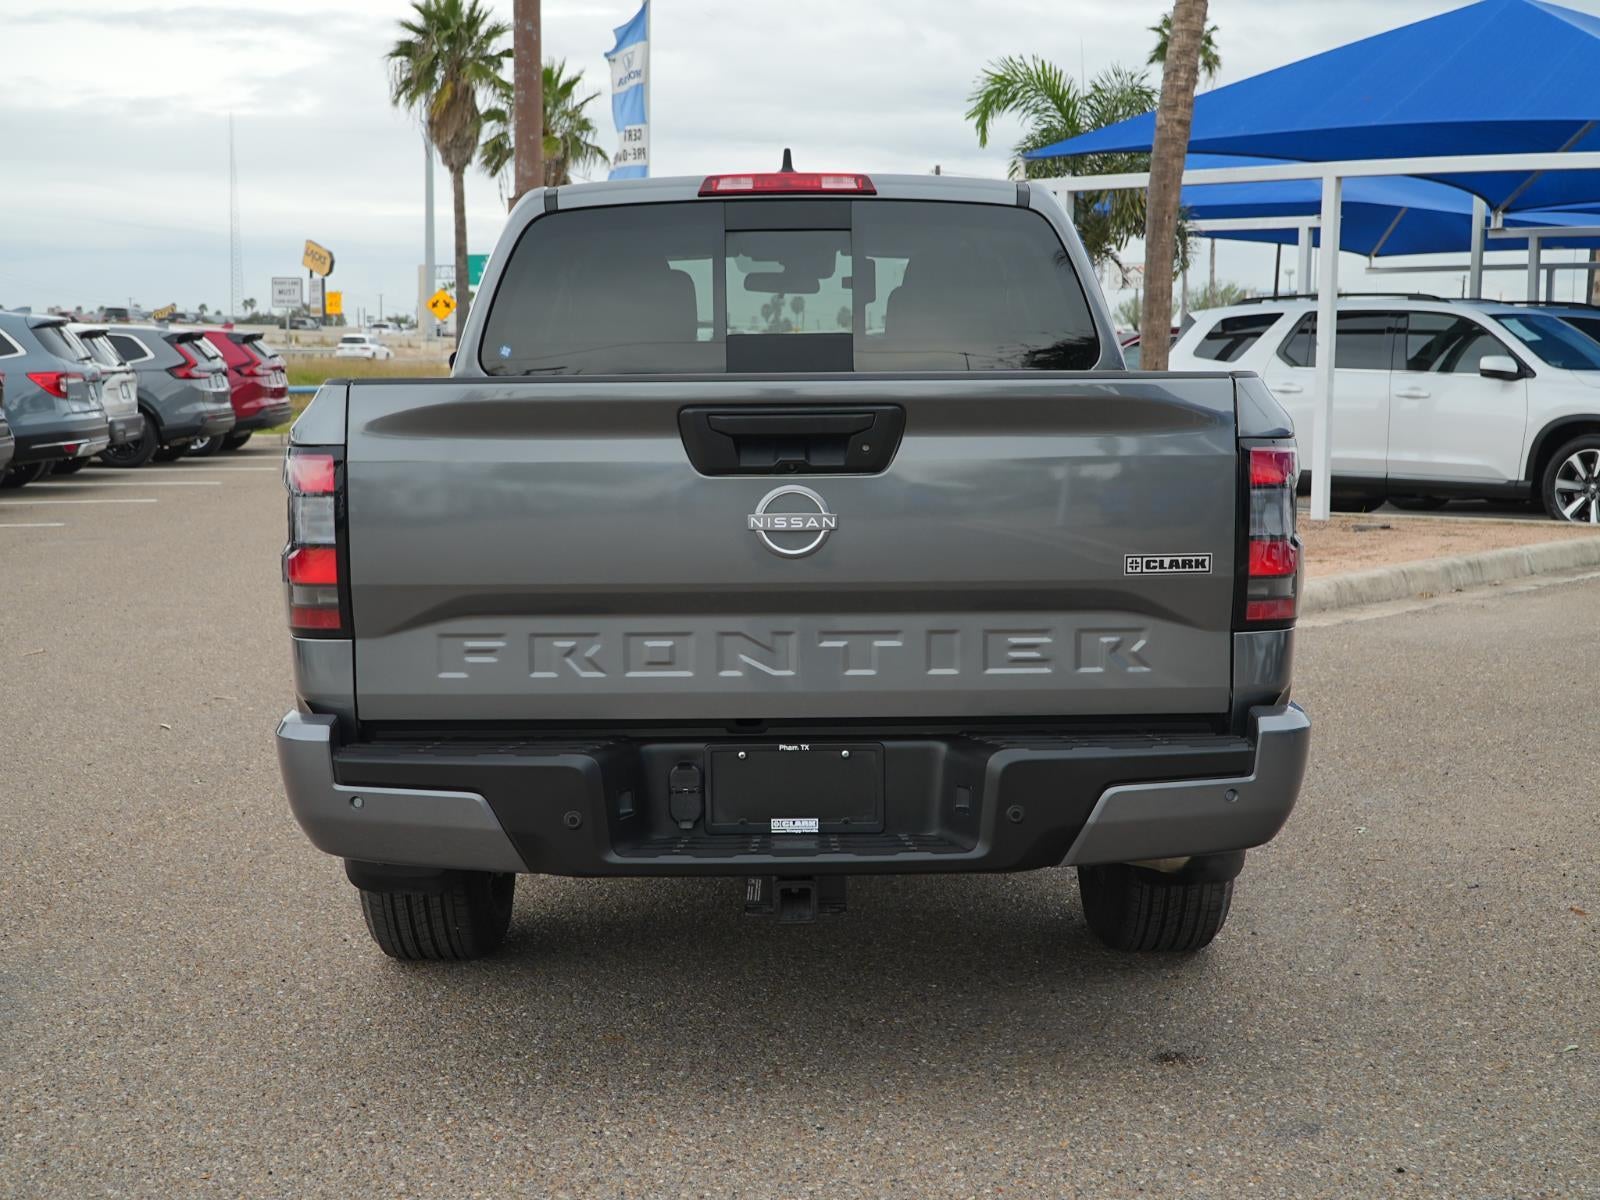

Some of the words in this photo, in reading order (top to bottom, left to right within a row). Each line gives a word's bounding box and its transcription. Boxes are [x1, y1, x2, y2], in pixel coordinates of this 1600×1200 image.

[750, 517, 836, 528] NISSAN
[1144, 558, 1207, 570] CLARK
[437, 630, 1152, 679] FRONTIER
[800, 744, 810, 752] TX
